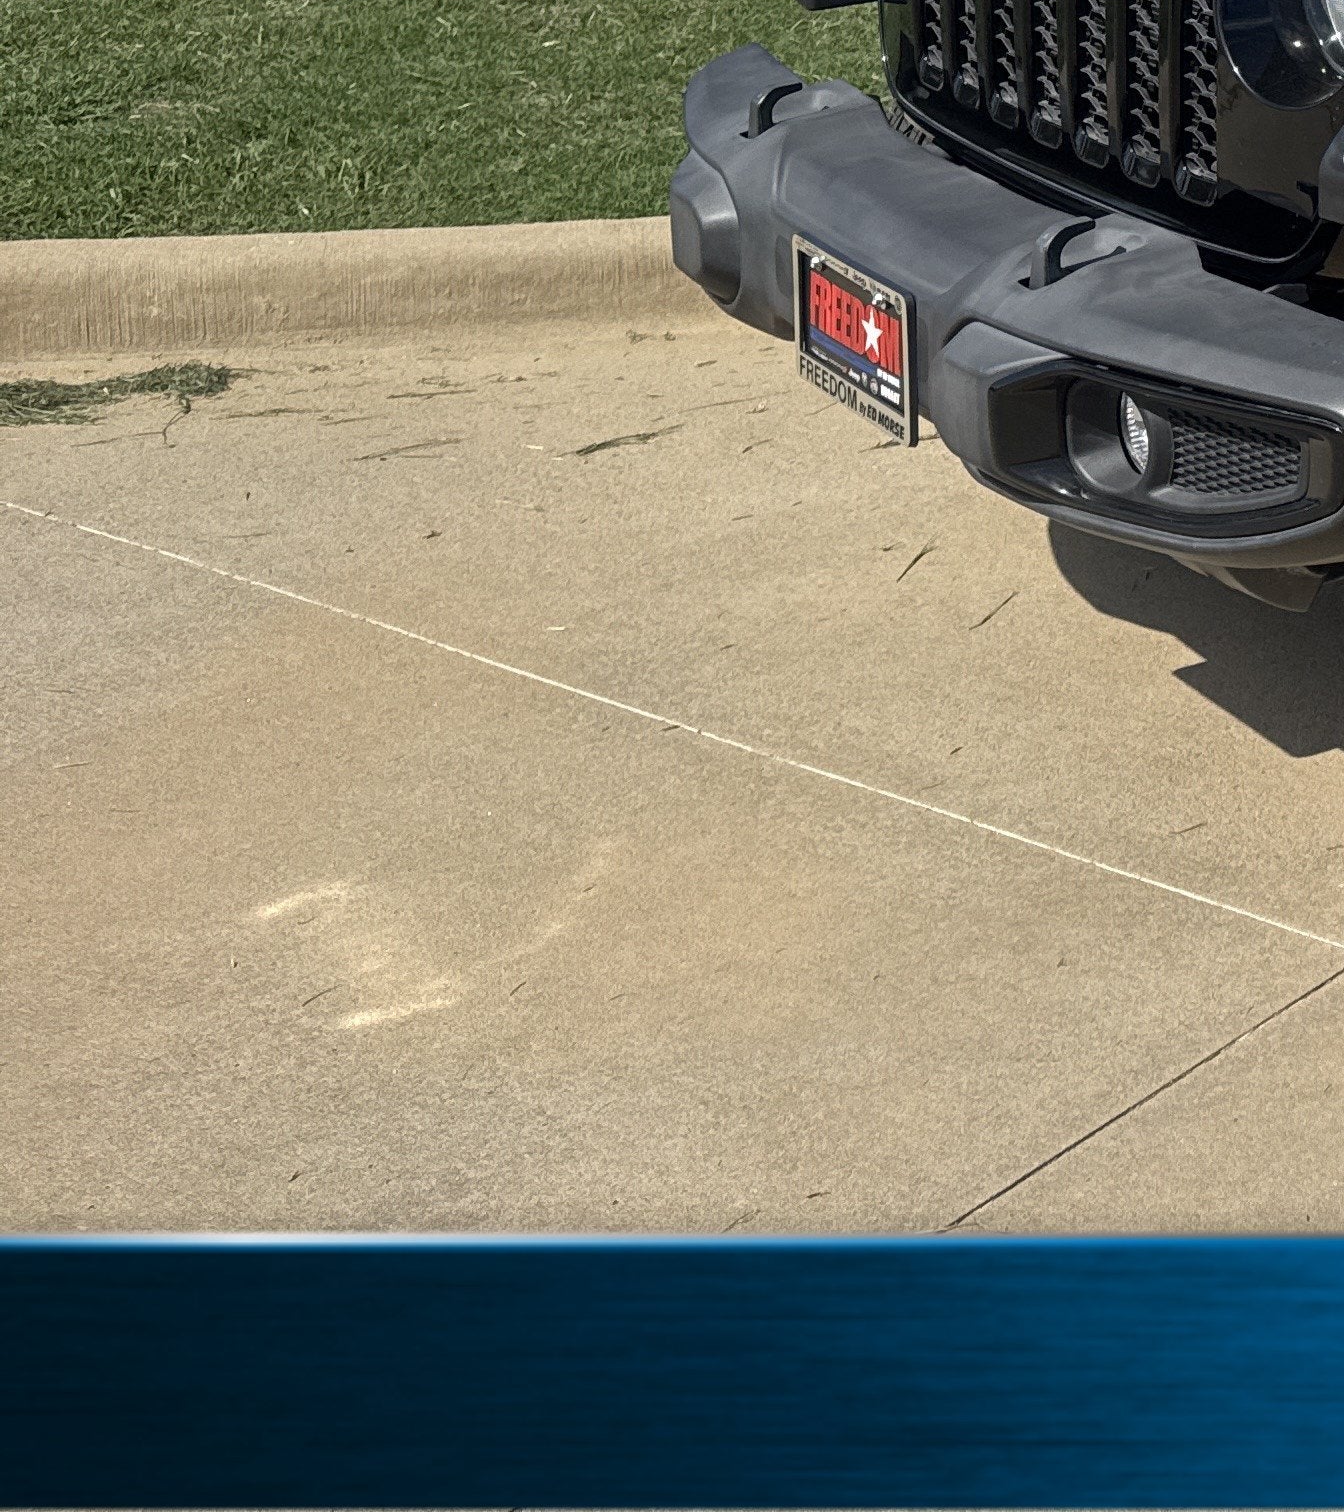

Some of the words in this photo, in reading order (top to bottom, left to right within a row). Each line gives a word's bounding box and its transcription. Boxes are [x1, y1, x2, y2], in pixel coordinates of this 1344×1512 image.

[810, 270, 901, 378] FREEDOM
[800, 354, 858, 412] FREEDOM
[878, 411, 905, 441] MORSE
